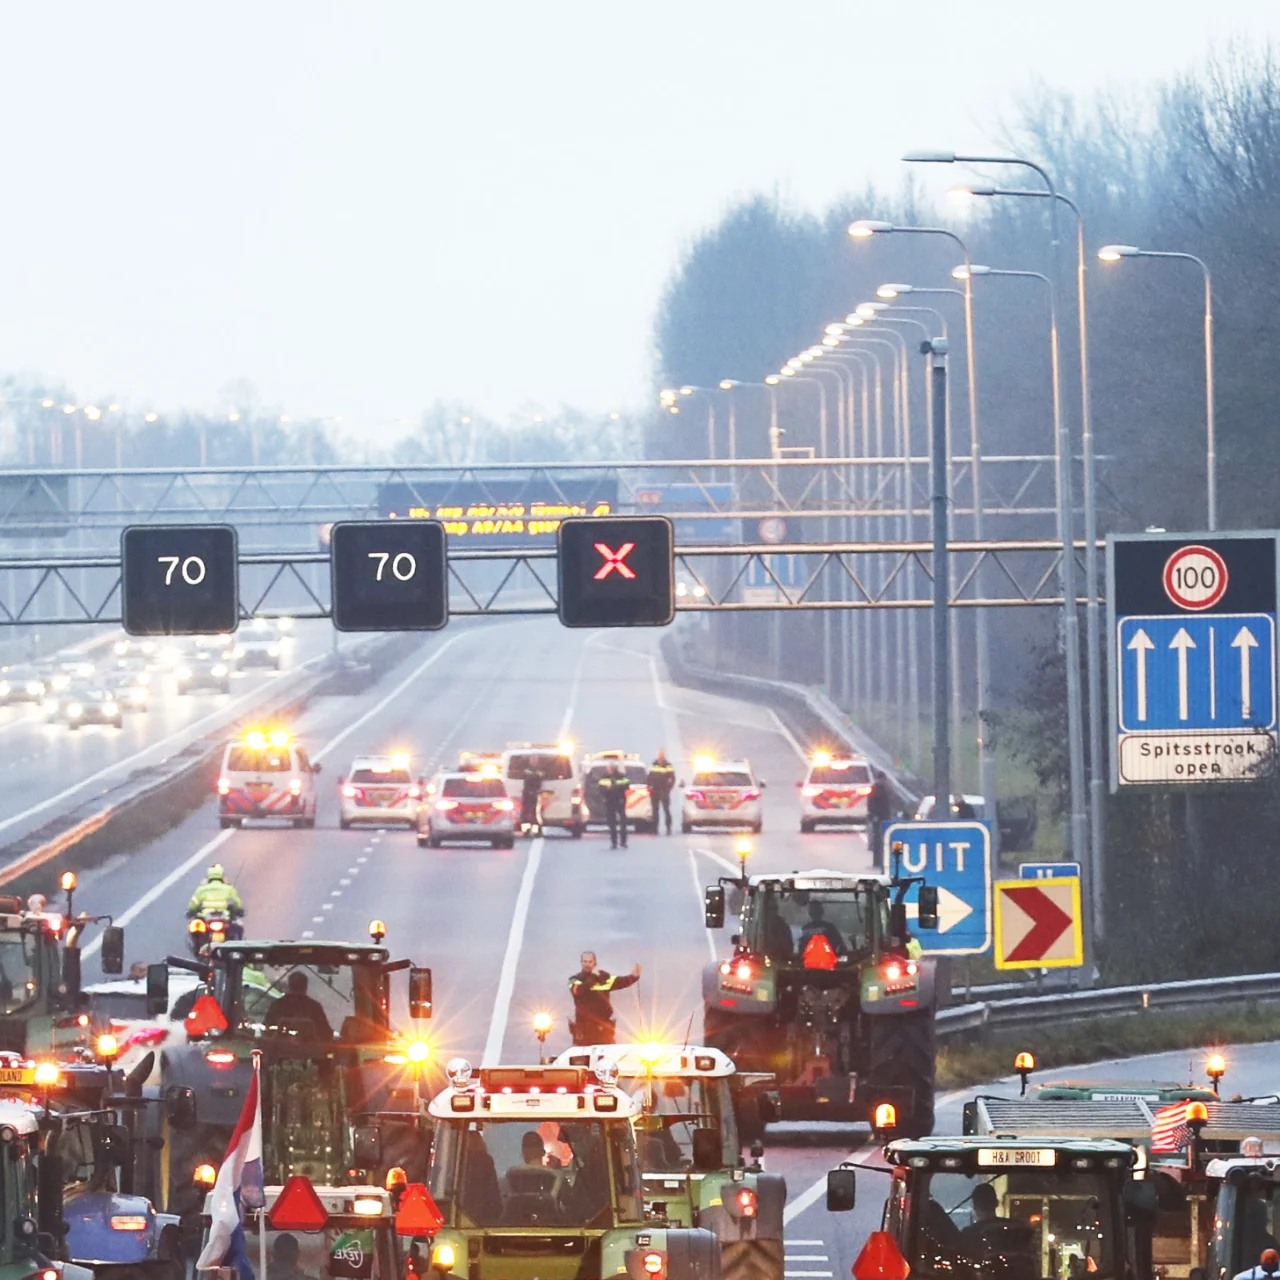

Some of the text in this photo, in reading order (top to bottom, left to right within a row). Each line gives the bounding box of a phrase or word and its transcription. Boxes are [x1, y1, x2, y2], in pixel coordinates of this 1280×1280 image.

[157, 556, 206, 585] 70
[368, 552, 417, 581] 70
[1175, 566, 1216, 590] 100
[1140, 741, 1256, 759] Spitsstrook
[1175, 761, 1221, 776] open
[902, 842, 971, 873] UIT
[992, 1151, 1041, 1163] H&A GROOT
